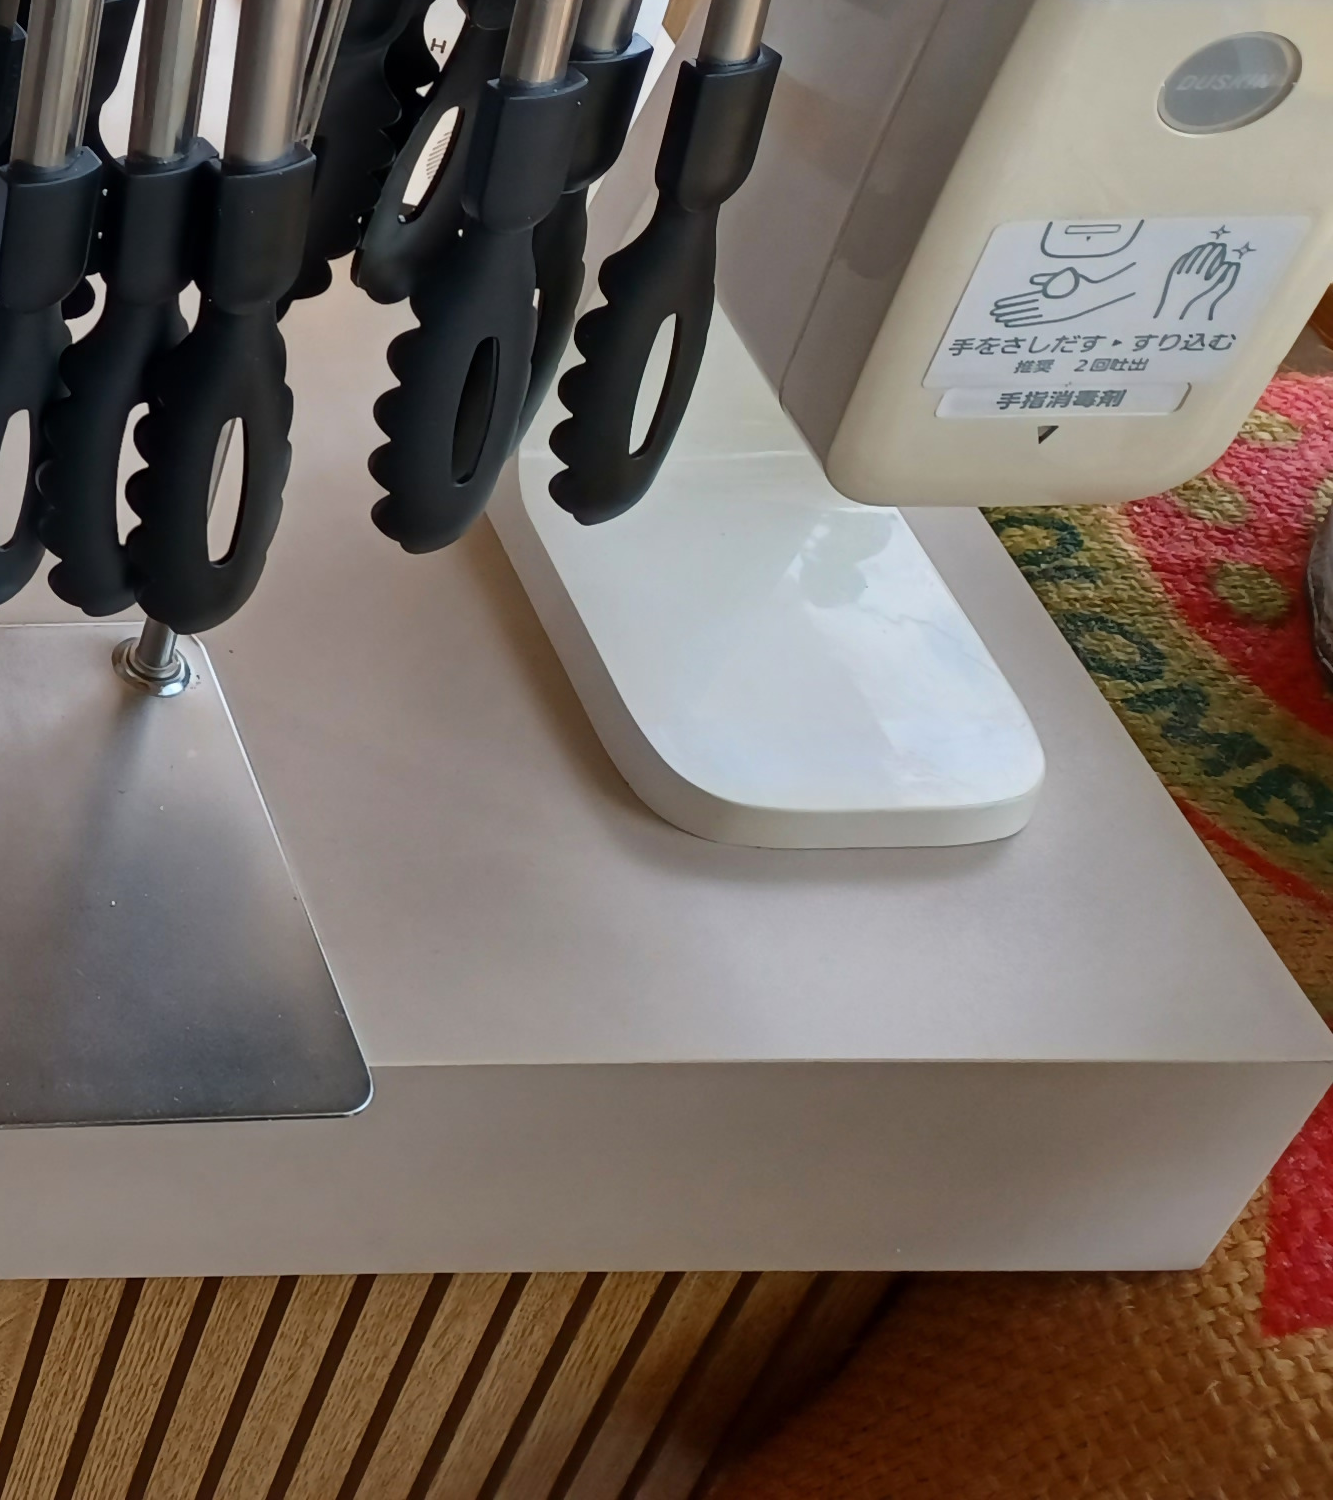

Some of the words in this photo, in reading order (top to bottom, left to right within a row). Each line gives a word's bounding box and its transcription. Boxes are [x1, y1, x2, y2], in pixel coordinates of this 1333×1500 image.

[947, 333, 1107, 357] 手をさしだす
[1132, 332, 1238, 353] すり込む
[994, 388, 1128, 411] 手指消毒剤
